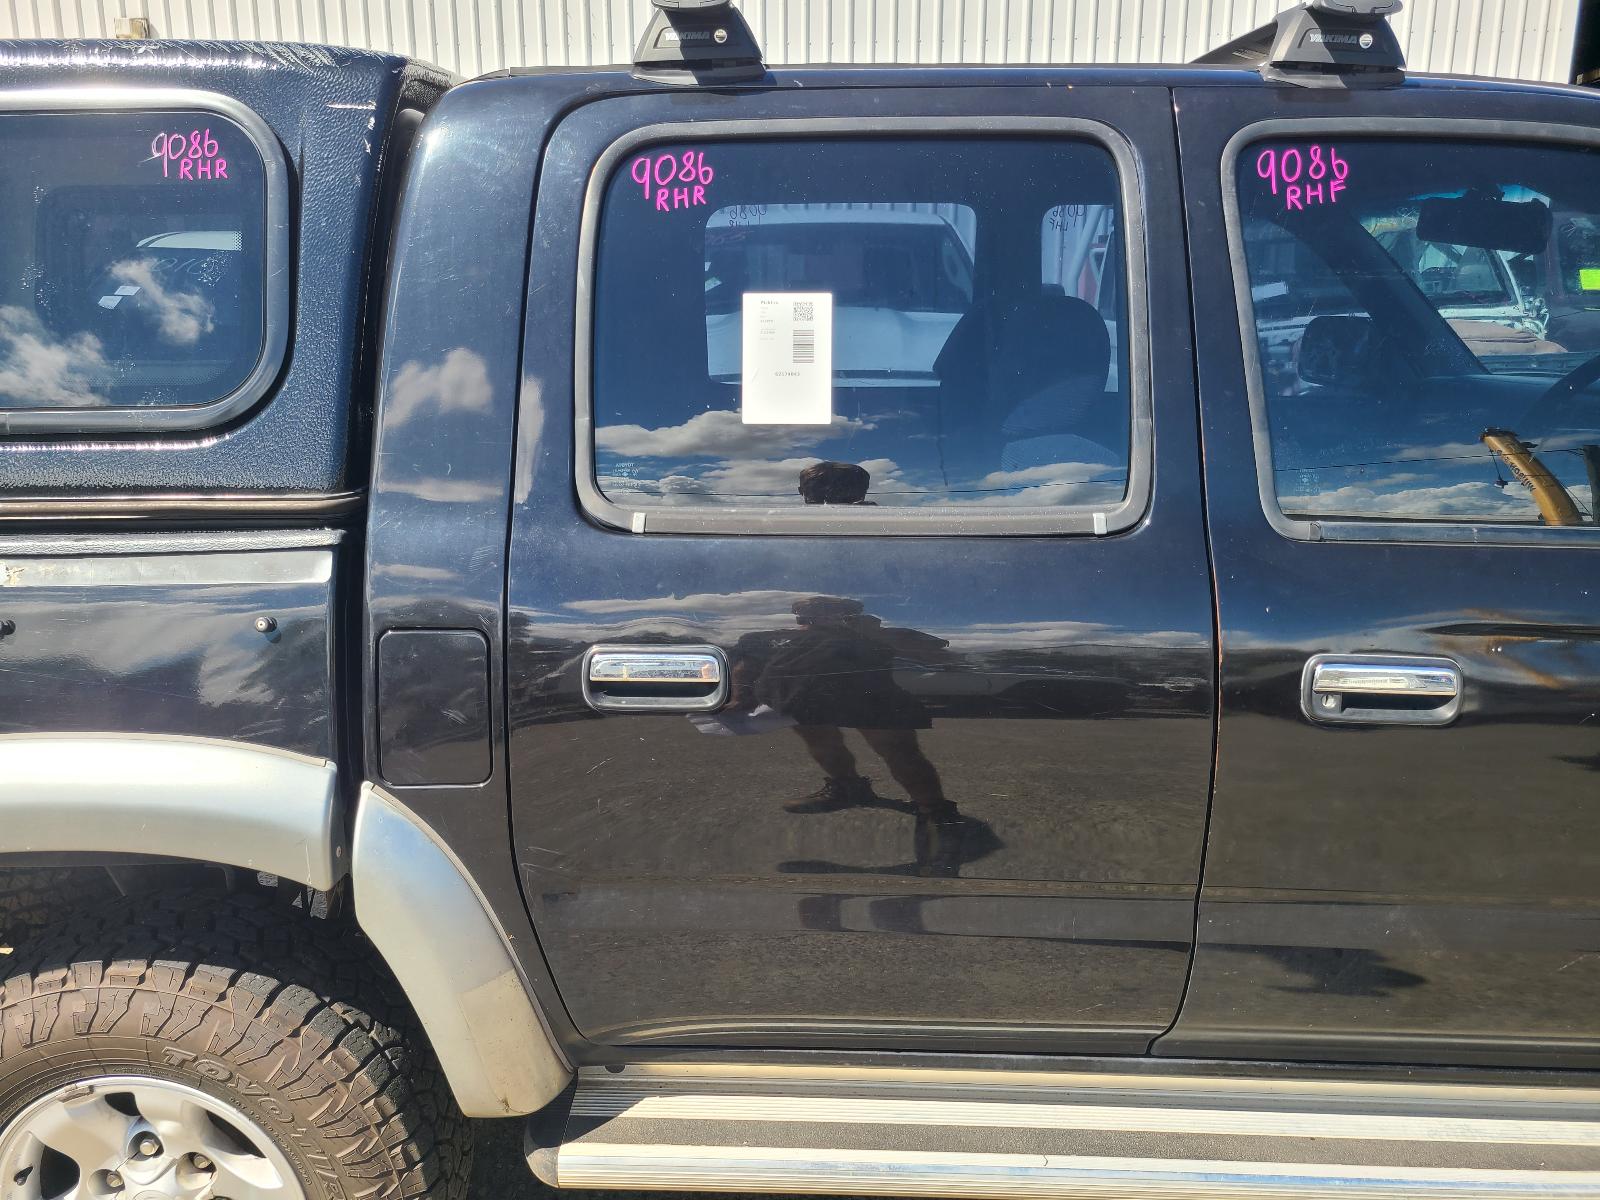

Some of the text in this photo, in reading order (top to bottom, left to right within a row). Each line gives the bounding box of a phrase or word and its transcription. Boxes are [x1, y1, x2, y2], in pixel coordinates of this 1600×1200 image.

[151, 128, 219, 177] 9086
[179, 158, 228, 180] RHR
[631, 151, 714, 200] 9086
[1256, 145, 1348, 195] 9086
[656, 185, 706, 212] RHR
[1286, 180, 1346, 210] RHF
[162, 1046, 295, 1124] TOYO
